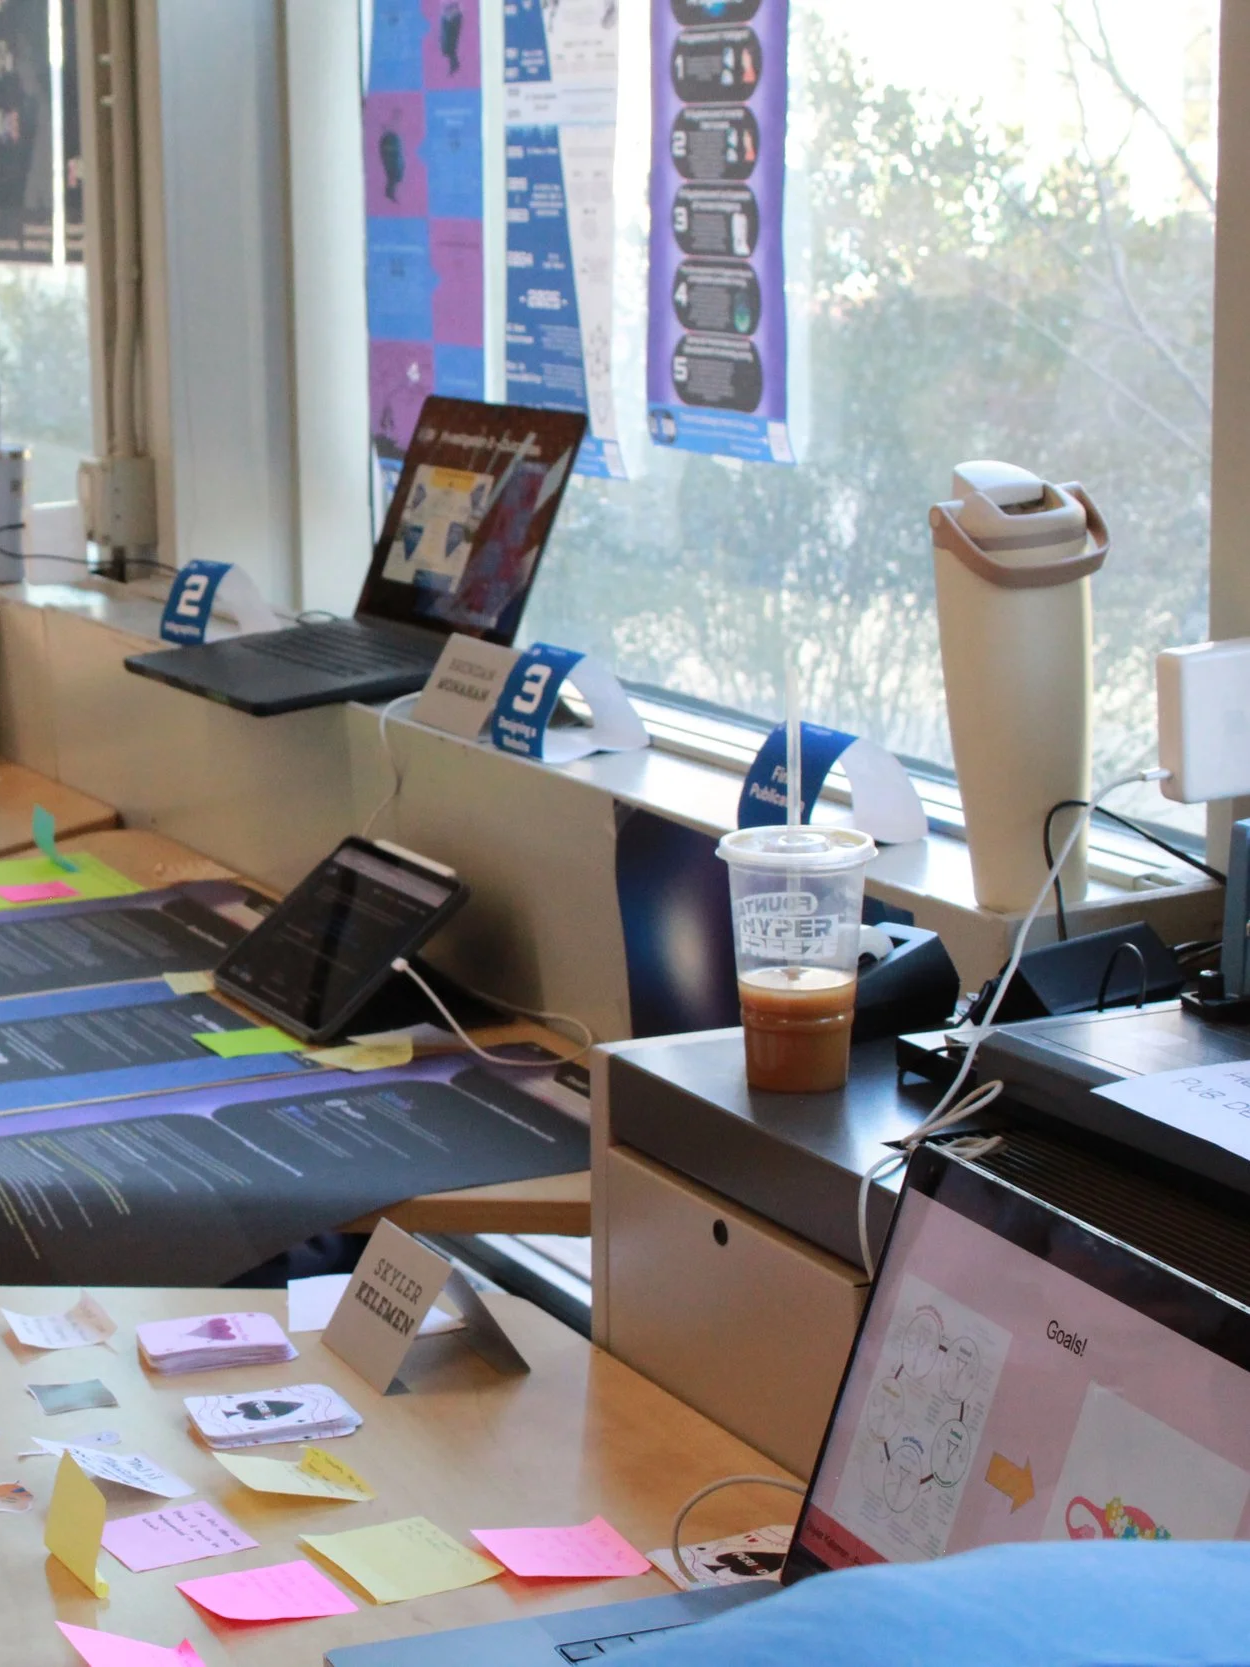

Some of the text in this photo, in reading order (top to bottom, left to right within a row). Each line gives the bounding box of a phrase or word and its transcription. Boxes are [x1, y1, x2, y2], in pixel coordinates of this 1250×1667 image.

[675, 54, 684, 80] 1
[673, 131, 687, 157] 2
[673, 206, 688, 231] 3
[674, 282, 687, 306] 4
[674, 356, 688, 382] 5
[175, 574, 209, 617] 2
[512, 664, 552, 714] 3
[373, 1258, 423, 1305] SKYLER
[354, 1281, 415, 1337] KELEMEN
[1046, 1320, 1088, 1357] Goals!
